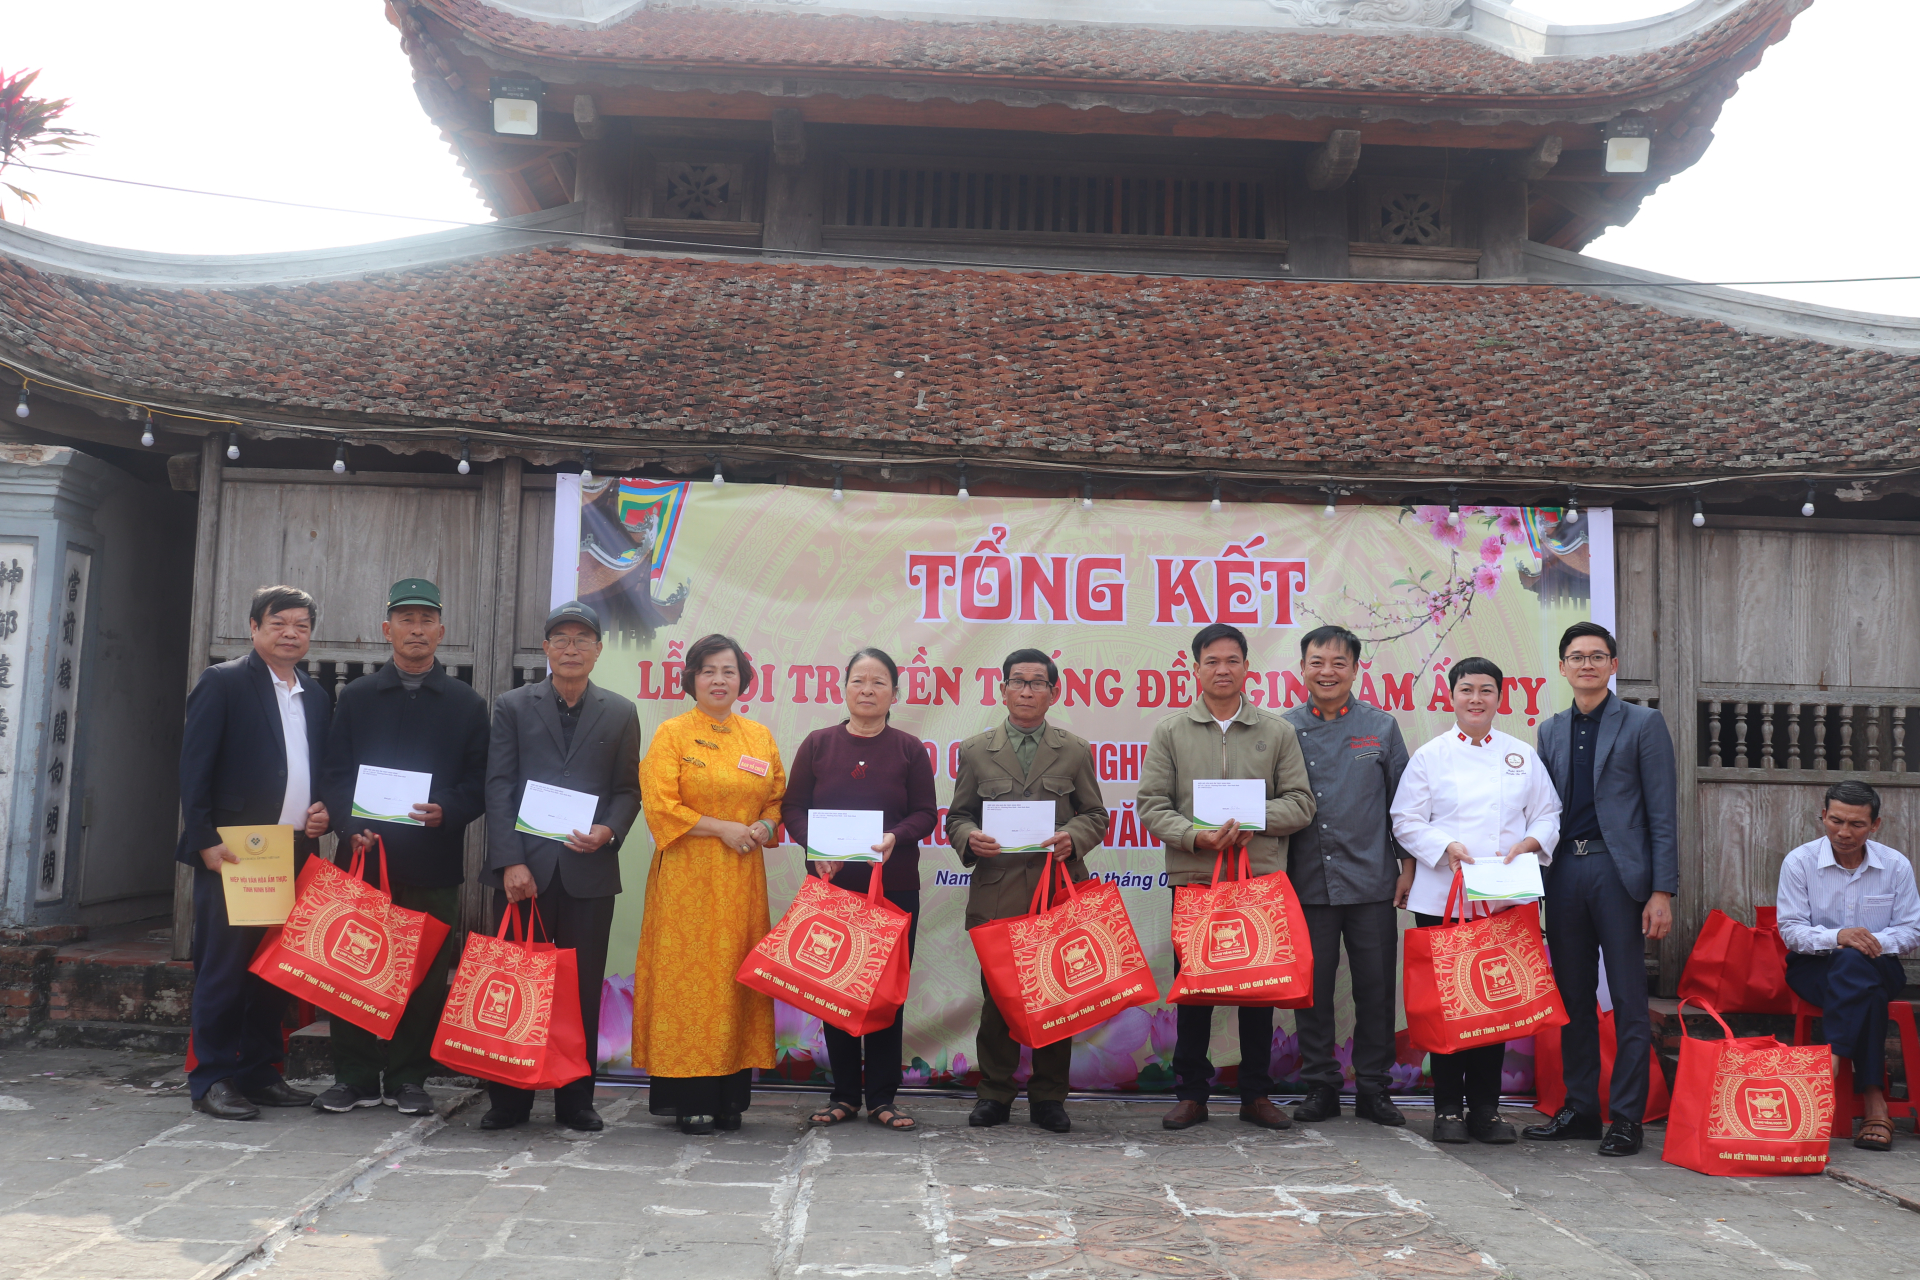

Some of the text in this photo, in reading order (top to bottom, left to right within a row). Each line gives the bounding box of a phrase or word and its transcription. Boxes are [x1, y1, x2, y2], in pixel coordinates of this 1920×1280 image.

[907, 524, 1307, 625] TỔNG KẾT
[637, 639, 686, 701] LỄ
[1136, 650, 1203, 709] ĐỀ
[1358, 658, 1416, 712] ĂM
